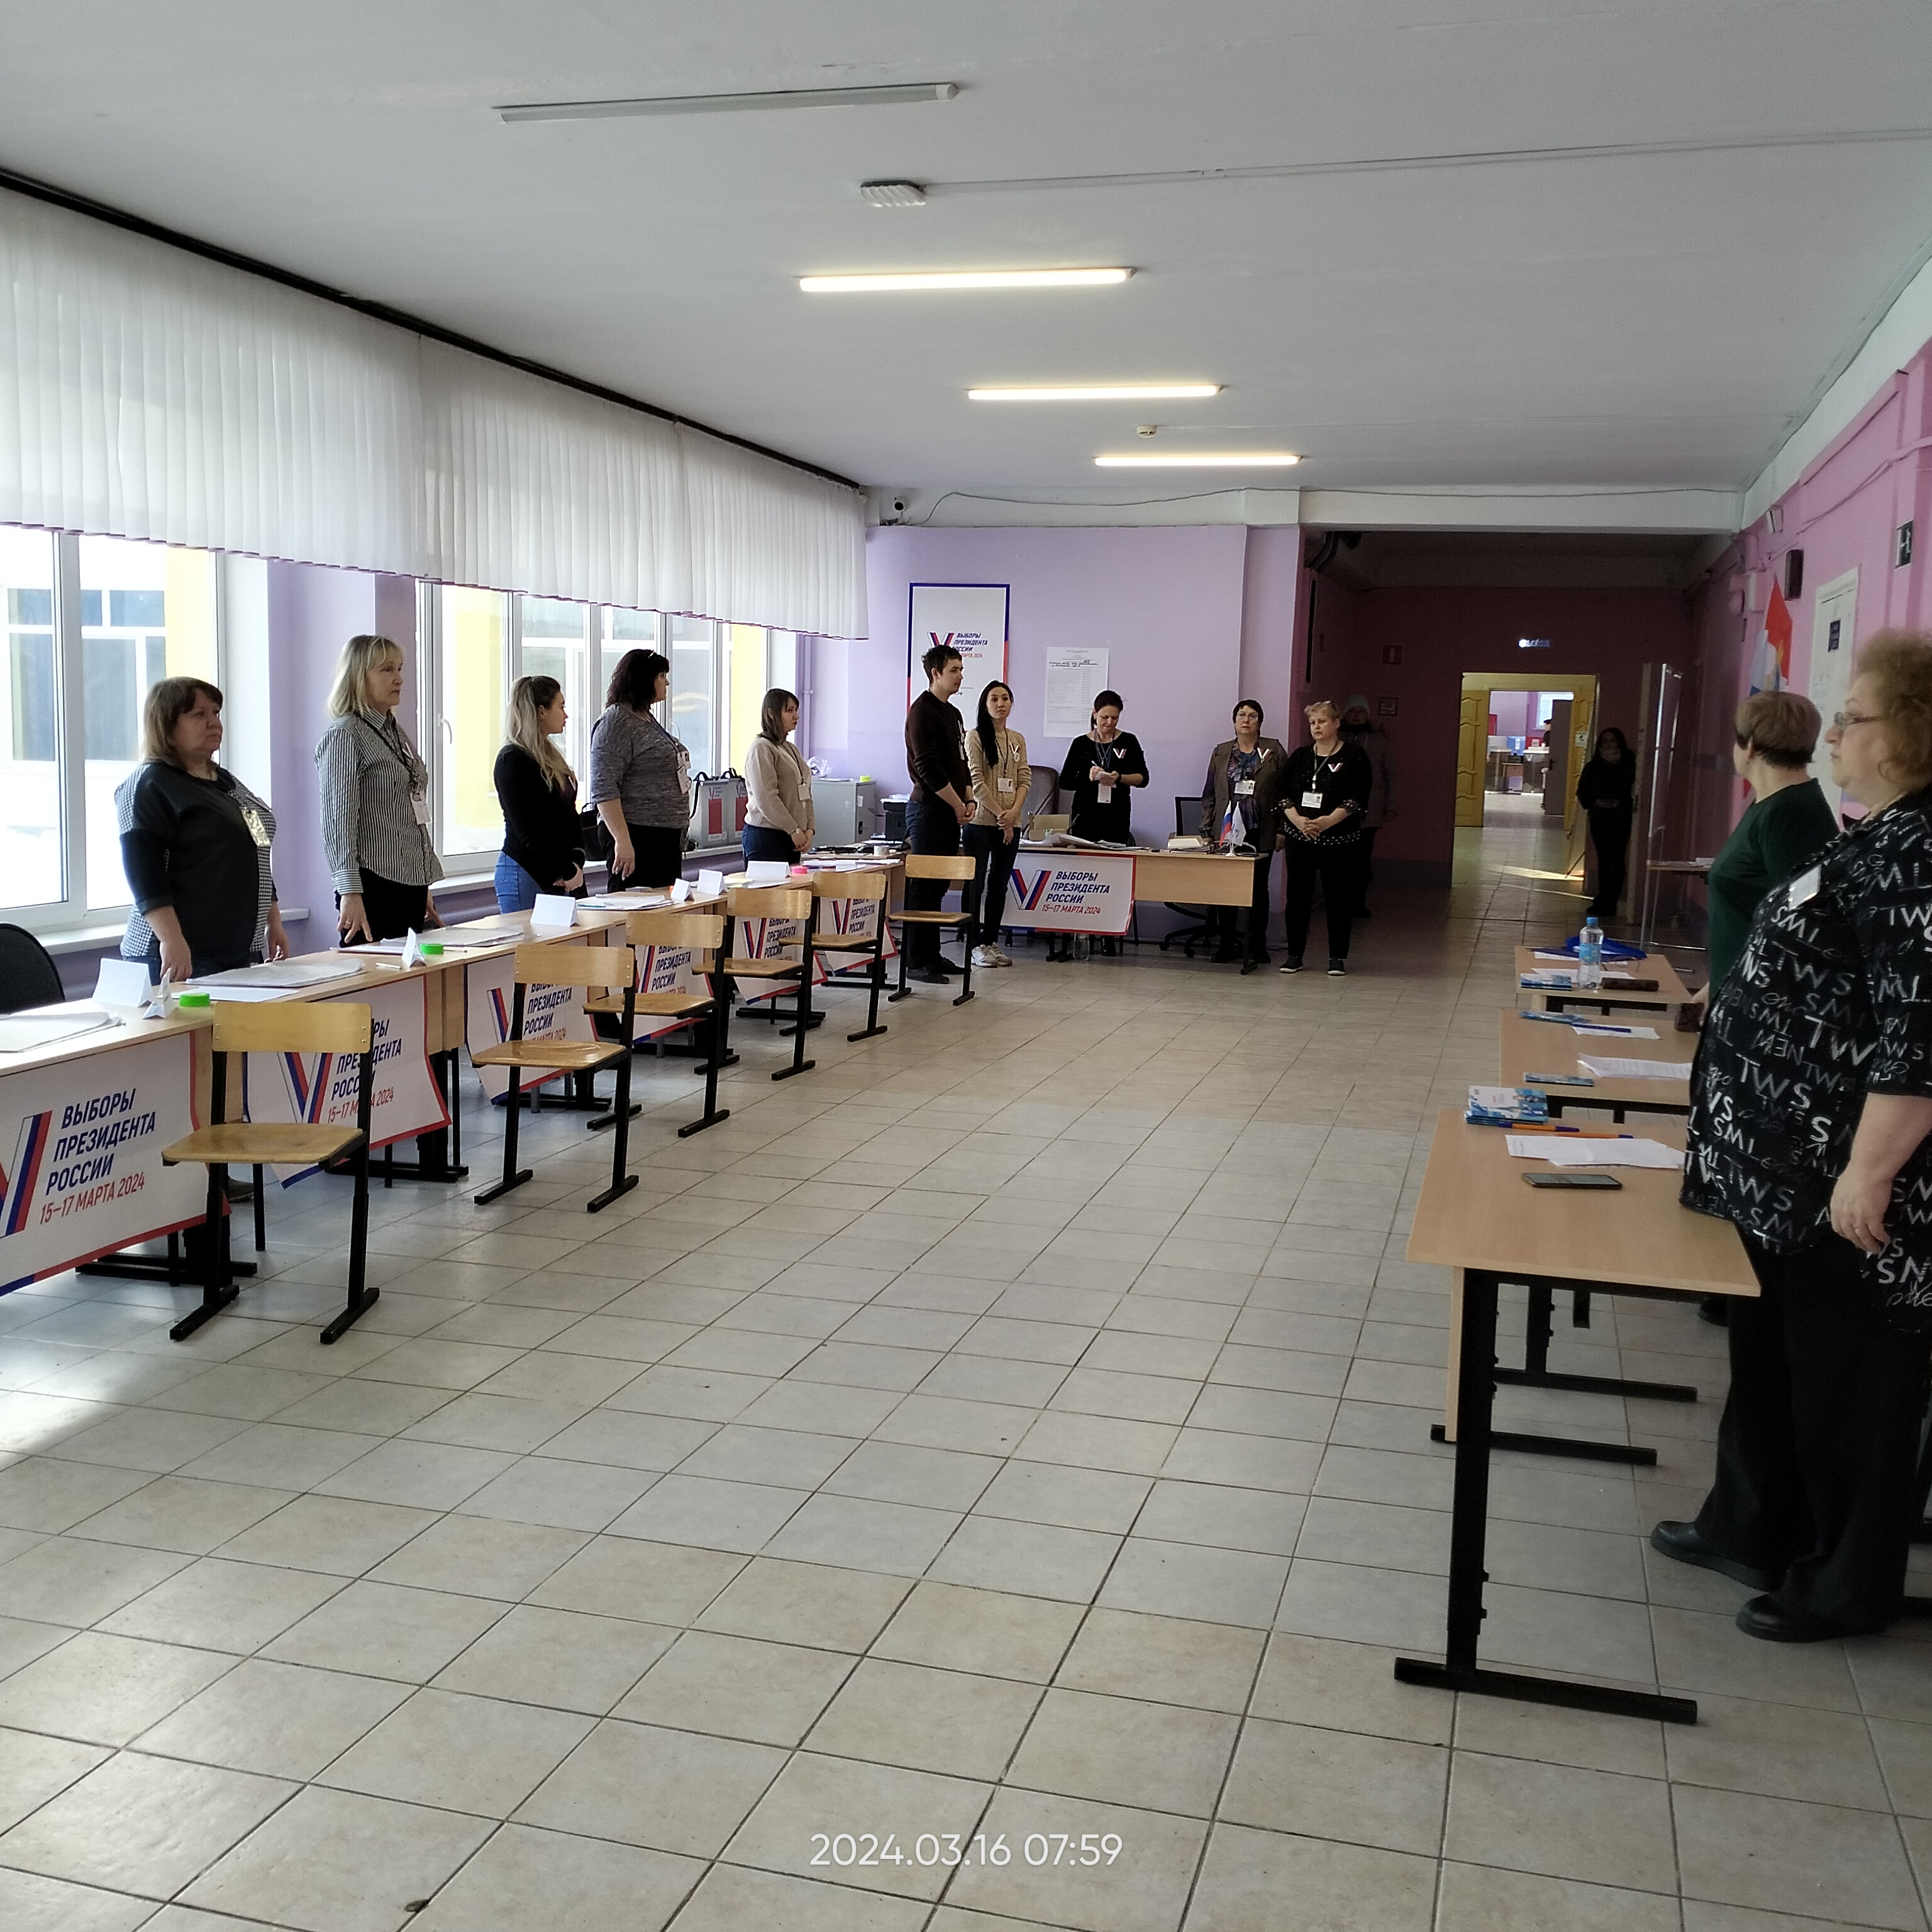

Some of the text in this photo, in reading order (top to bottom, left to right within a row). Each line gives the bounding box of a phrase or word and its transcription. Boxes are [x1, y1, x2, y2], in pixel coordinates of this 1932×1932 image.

[1056, 871, 1098, 881] ВЫБОРЫ
[1046, 893, 1084, 903] РОССИИ
[1050, 882, 1110, 894] ПРЕЗИДЕНТА
[1061, 905, 1083, 914] МАРТА
[1084, 906, 1101, 915] 2024
[655, 951, 691, 973] ПРЕЗИДЕНТА
[652, 972, 676, 991] РОССИИ
[527, 987, 572, 1015] ПРЕЗИДЕНТА
[523, 1012, 554, 1036] РОССИИ
[336, 1038, 402, 1074] ПРЕДЕНТА
[376, 1086, 394, 1107] 2024
[61, 1088, 136, 1130] ВЫБОРЫ
[53, 1111, 155, 1162] ПРЕЗИДЕНТА
[45, 1153, 114, 1196] РОССИИ
[75, 1181, 116, 1213] МАРТА
[117, 1171, 145, 1198] 2024
